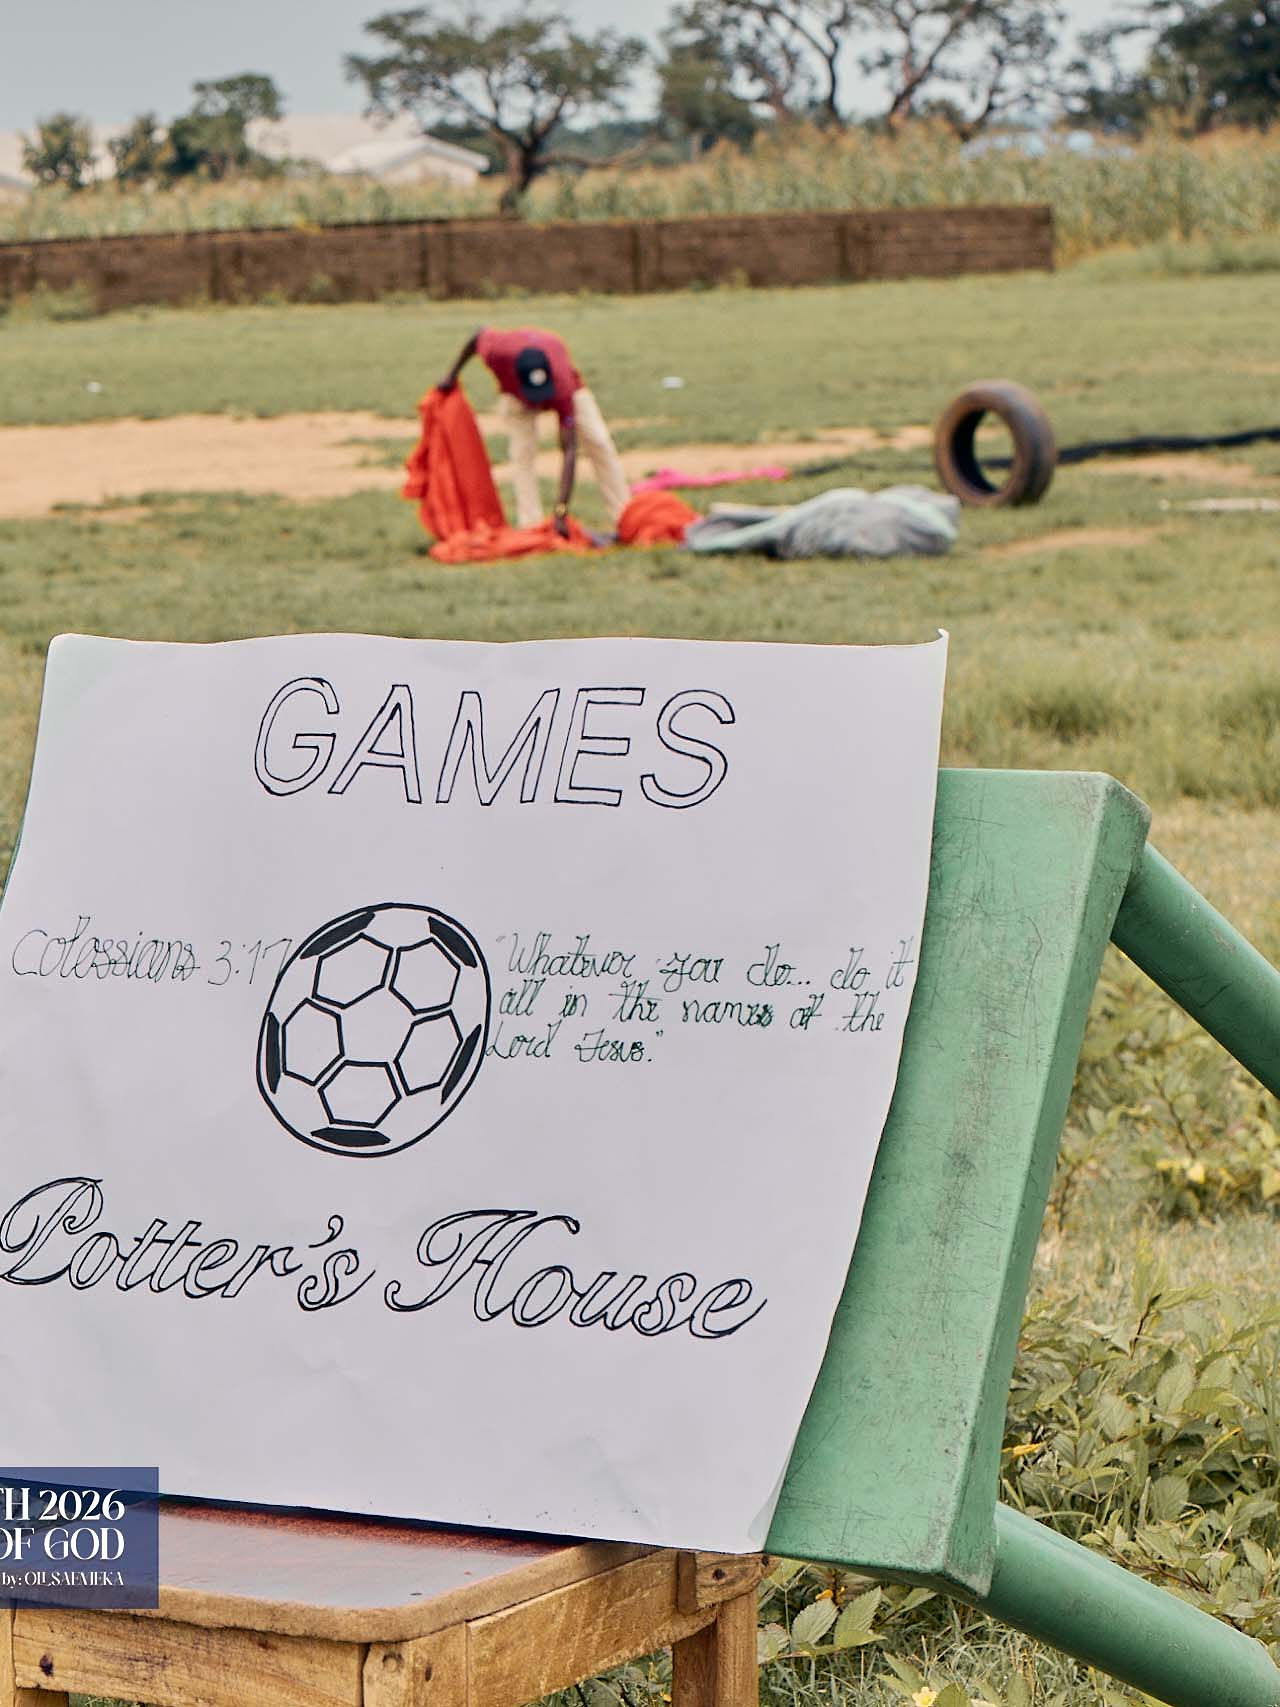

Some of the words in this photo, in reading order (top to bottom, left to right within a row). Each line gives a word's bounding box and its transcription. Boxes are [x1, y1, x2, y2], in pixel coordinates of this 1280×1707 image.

[254, 677, 736, 809] GAMES
[11, 915, 201, 984] Colossians
[207, 938, 293, 986] 3:17
[830, 947, 871, 990] do
[886, 936, 915, 989] it
[499, 978, 546, 1016] all
[559, 985, 588, 1018] in
[607, 979, 664, 1022] the
[789, 992, 824, 1031] of
[840, 991, 886, 1032] the
[486, 1019, 563, 1060] Lord
[384, 1208, 768, 1339] House
